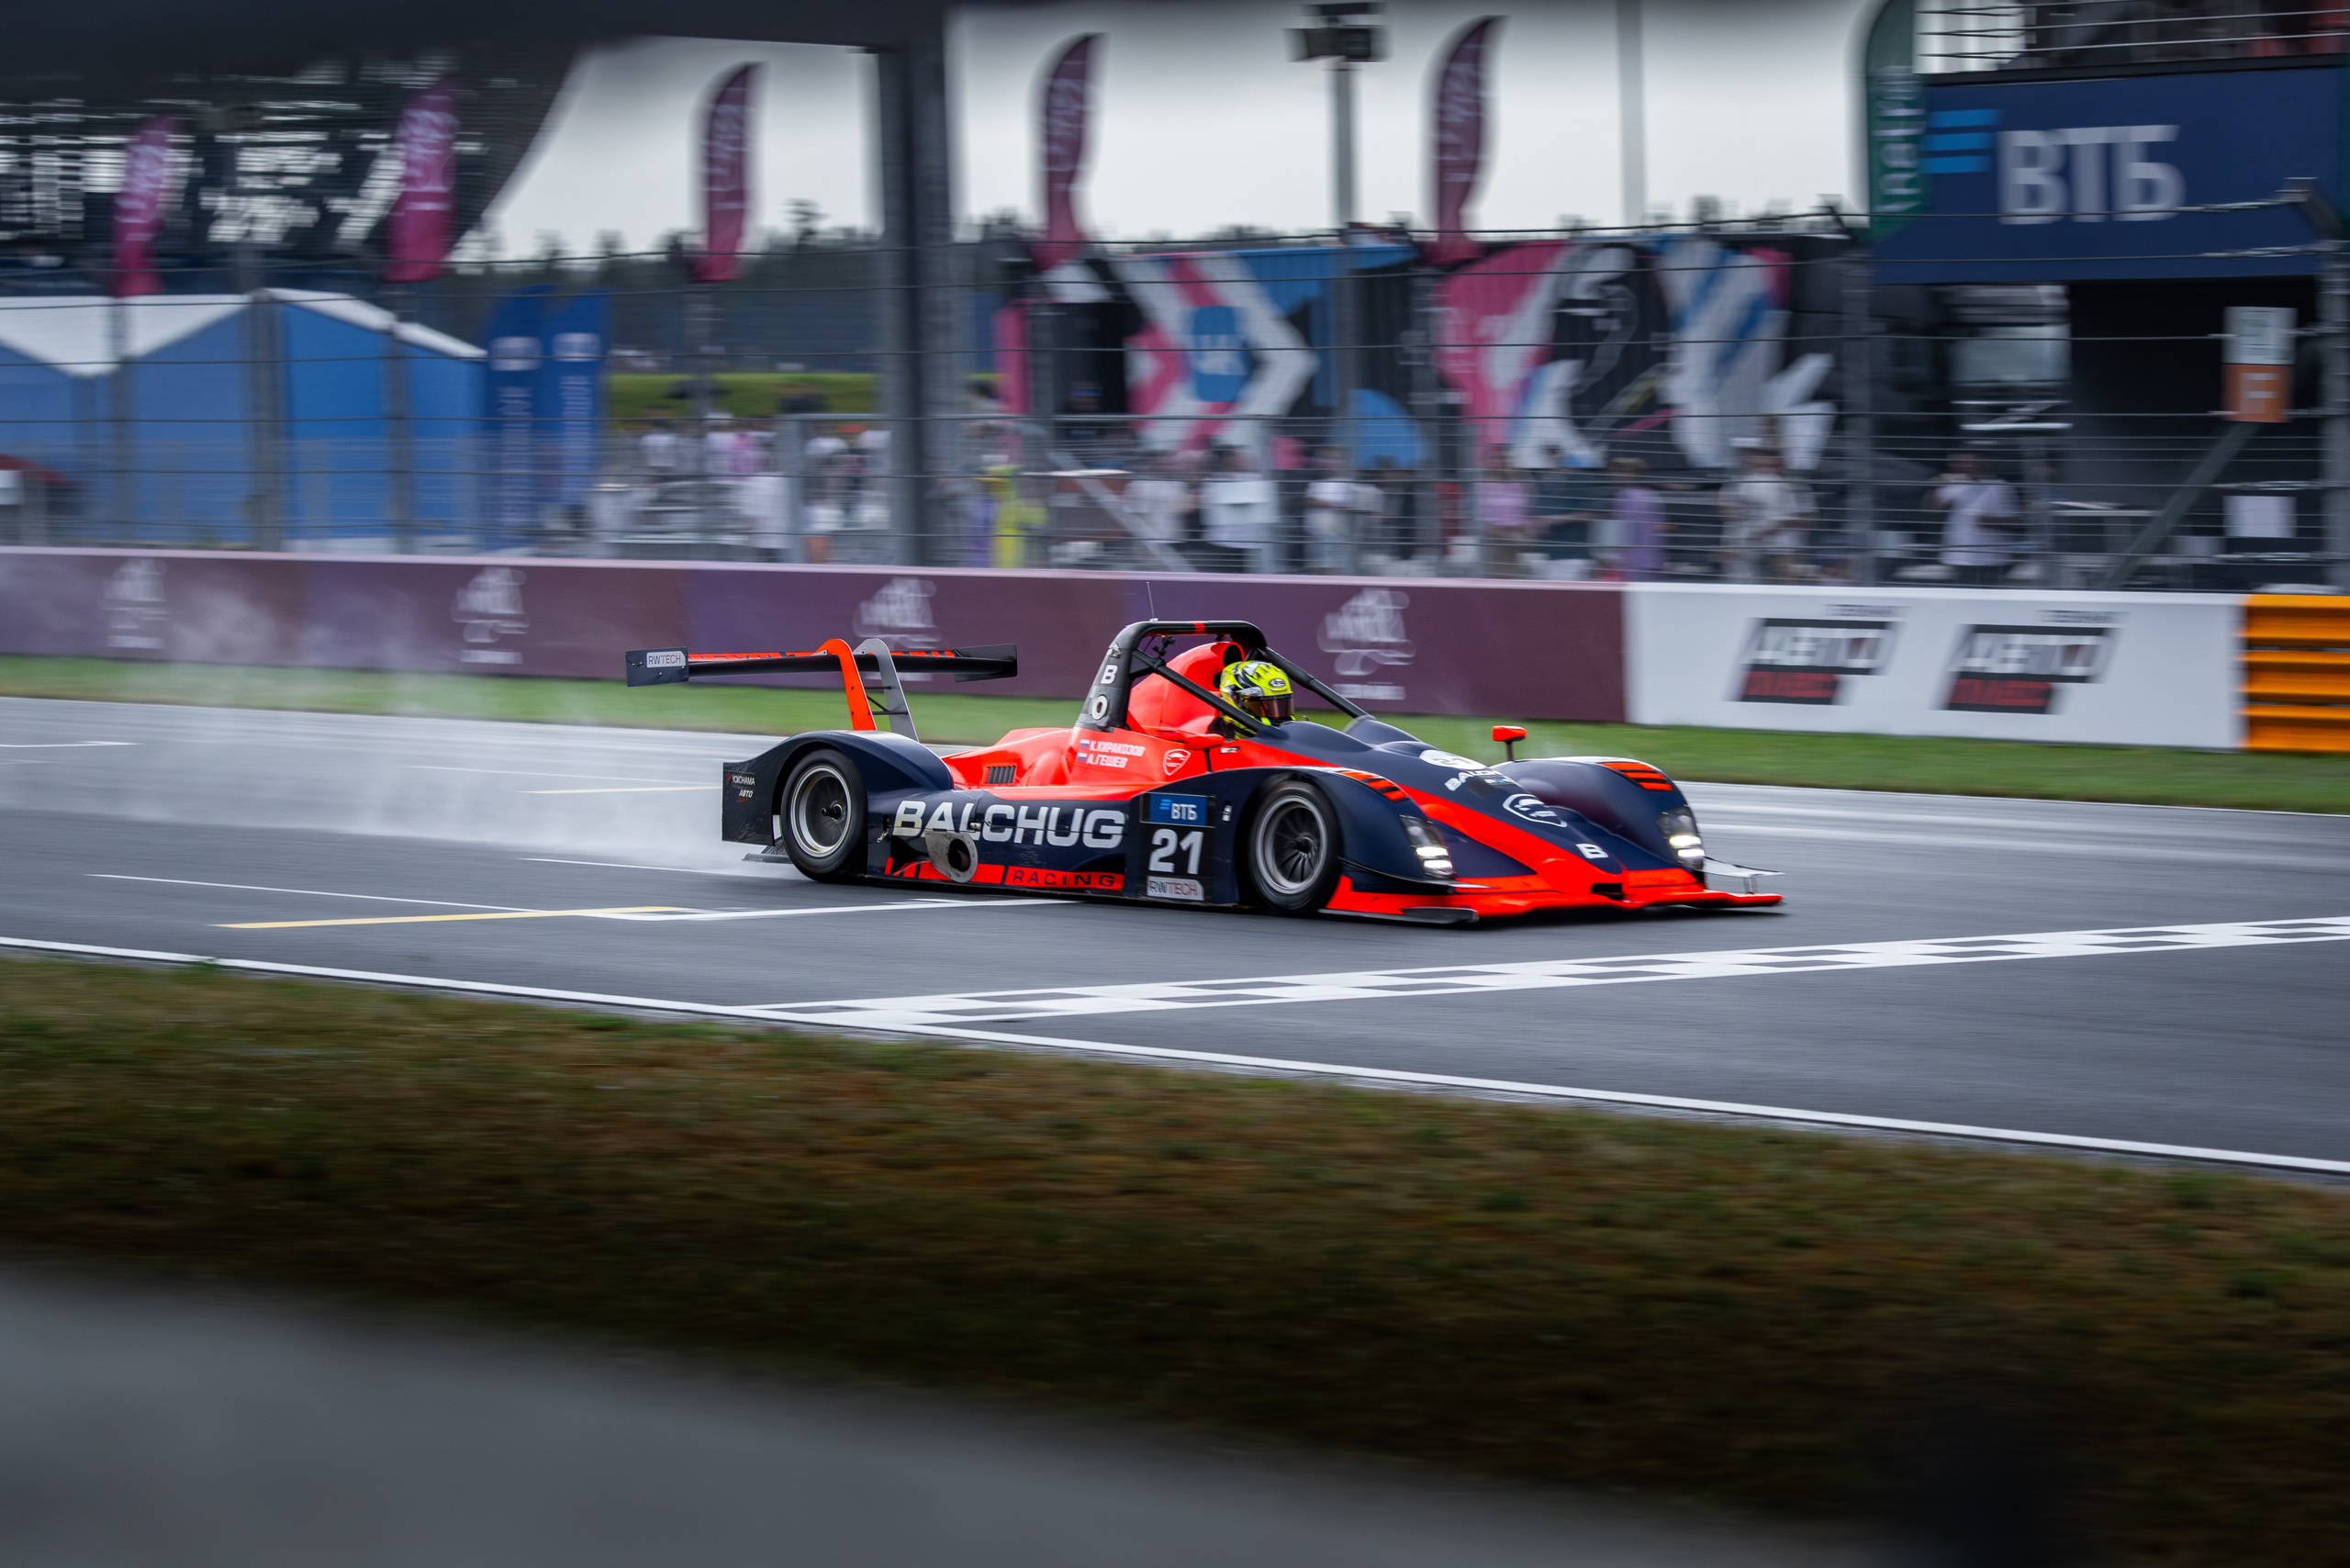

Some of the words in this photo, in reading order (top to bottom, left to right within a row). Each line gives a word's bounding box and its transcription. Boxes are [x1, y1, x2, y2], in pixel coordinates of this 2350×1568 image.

[1999, 125, 2187, 225] ВТБ
[647, 655, 682, 666] RWTECH
[1100, 665, 1119, 685] B
[1086, 754, 1128, 768] А.ГЕШЕВ
[1170, 803, 1199, 822] ВТБ
[892, 800, 1125, 848] BALCHUG
[1147, 828, 1203, 875] 21
[1575, 843, 1609, 858] B
[1013, 869, 1116, 887] RACING
[1148, 879, 1199, 897] RWTECH
